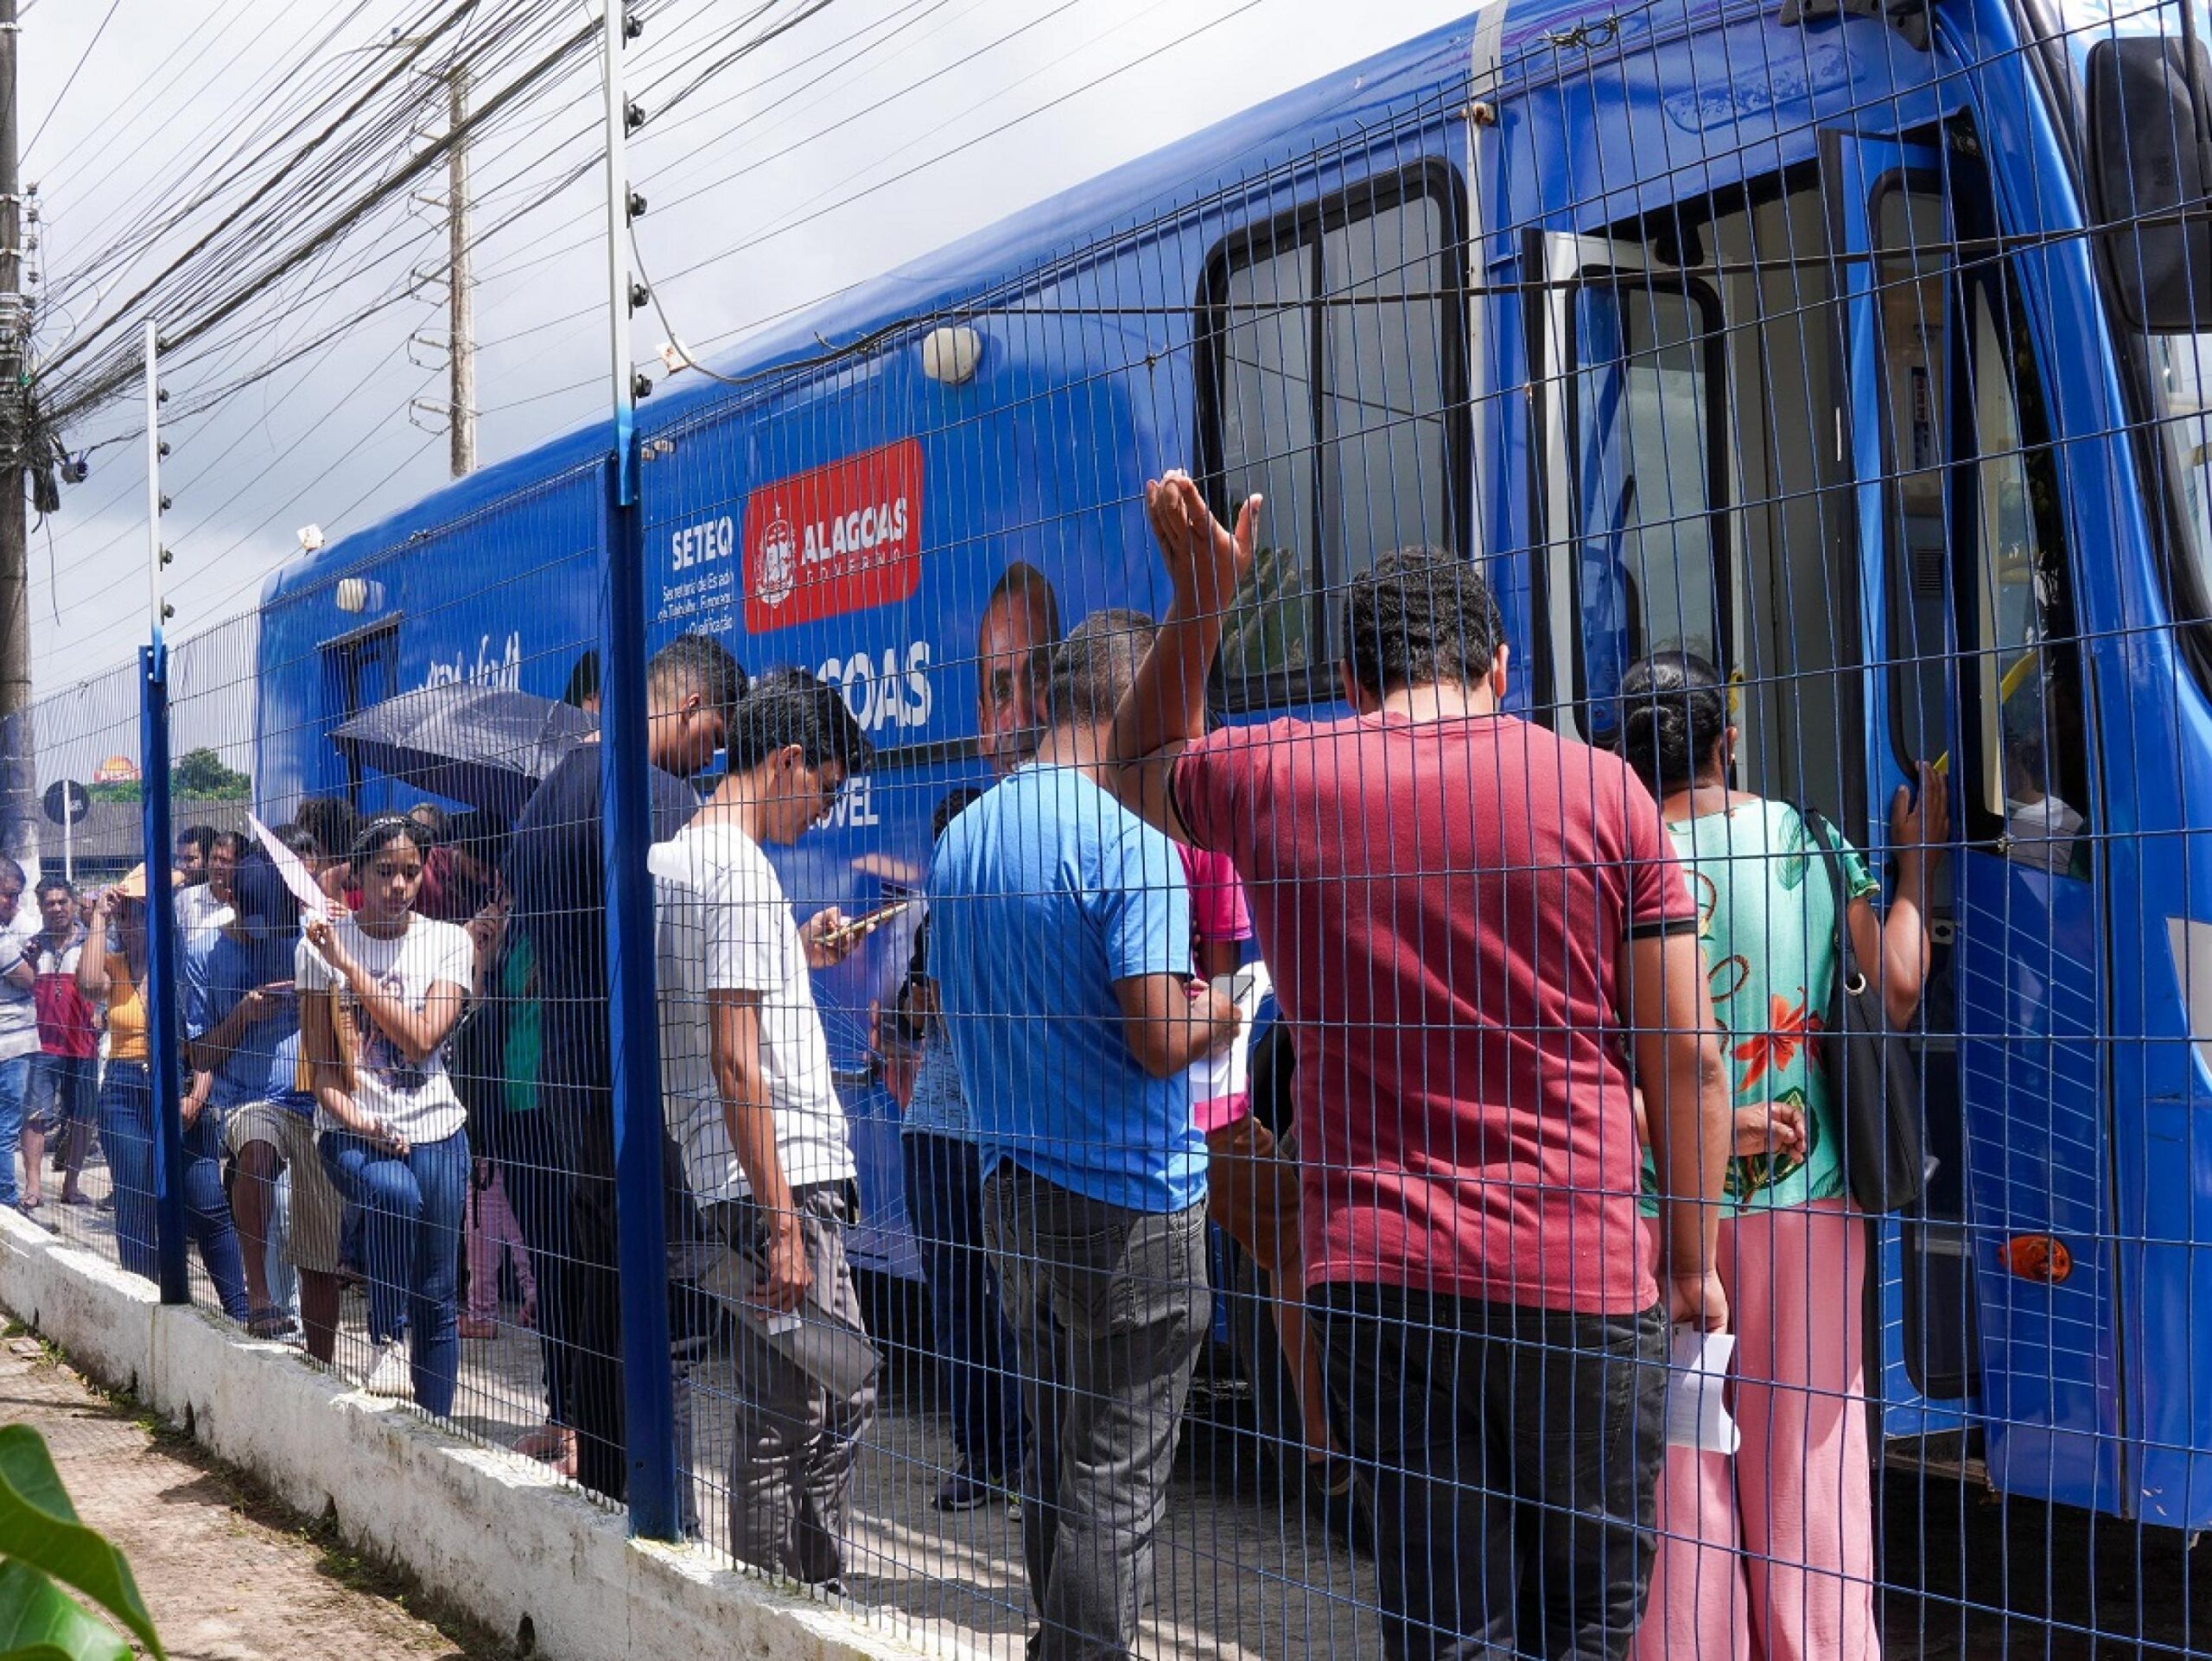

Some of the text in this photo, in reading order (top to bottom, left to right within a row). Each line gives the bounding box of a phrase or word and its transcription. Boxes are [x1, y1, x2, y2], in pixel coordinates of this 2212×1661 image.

[672, 516, 733, 571] SETEQ
[802, 497, 907, 567] ALAGOAS
[709, 567, 734, 589] Esado
